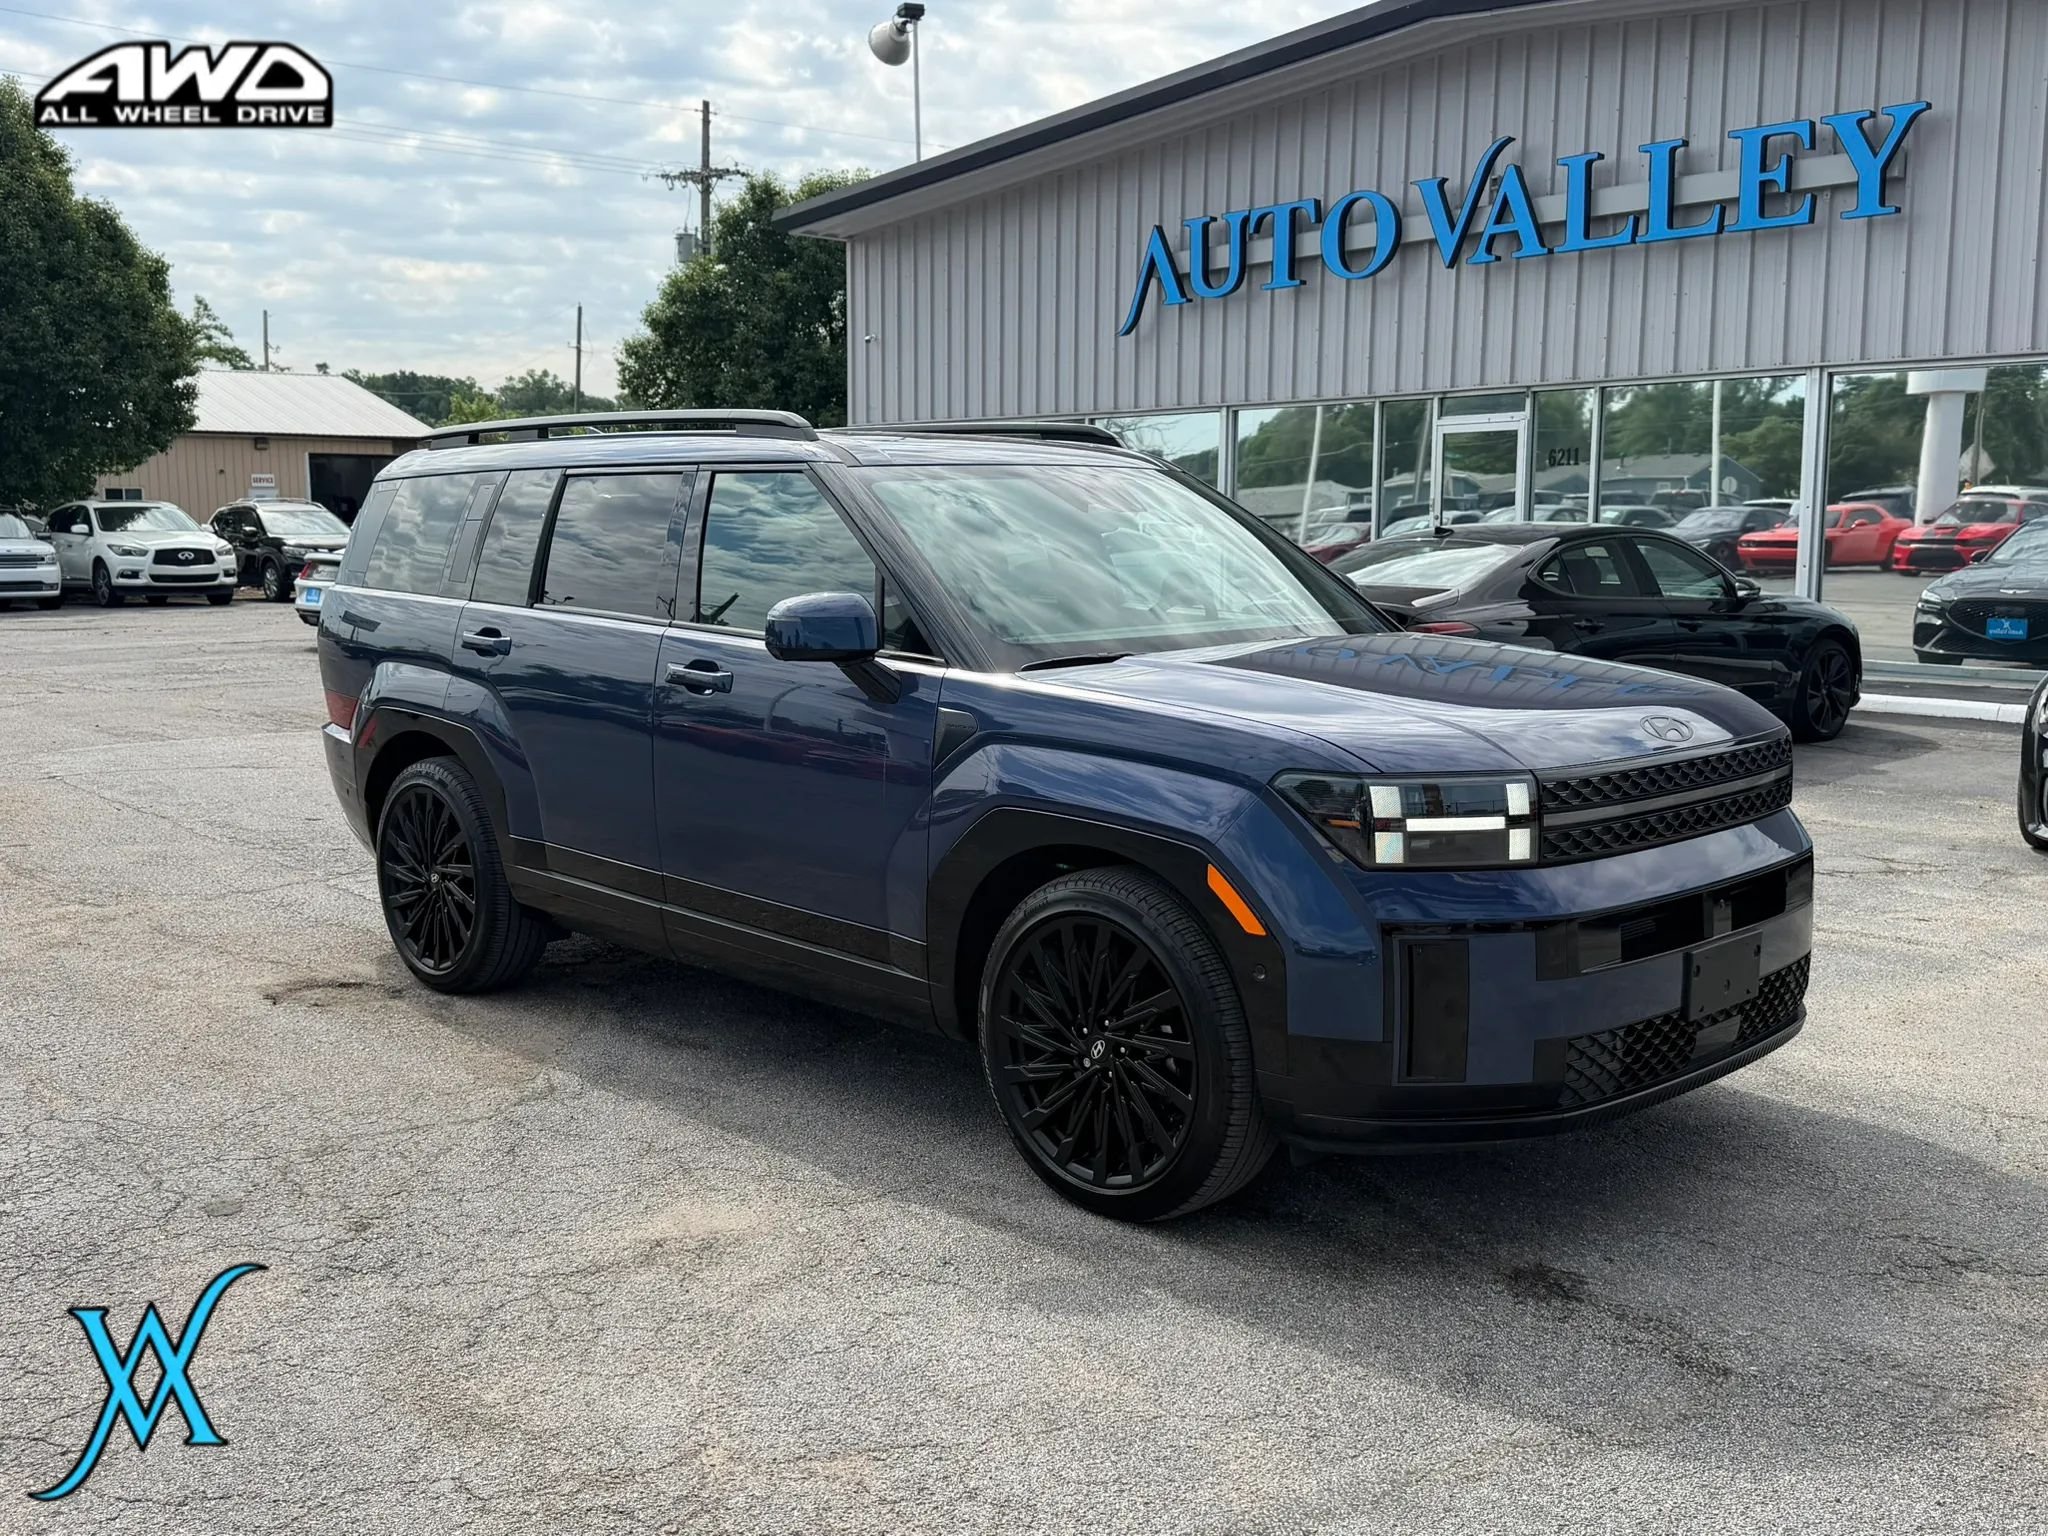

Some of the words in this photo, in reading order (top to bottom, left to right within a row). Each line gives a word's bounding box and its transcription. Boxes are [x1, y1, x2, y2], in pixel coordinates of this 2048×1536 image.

[1115, 190, 1402, 336] AUTO
[1411, 101, 1931, 269] VALLEY
[1549, 448, 1579, 467] 6211
